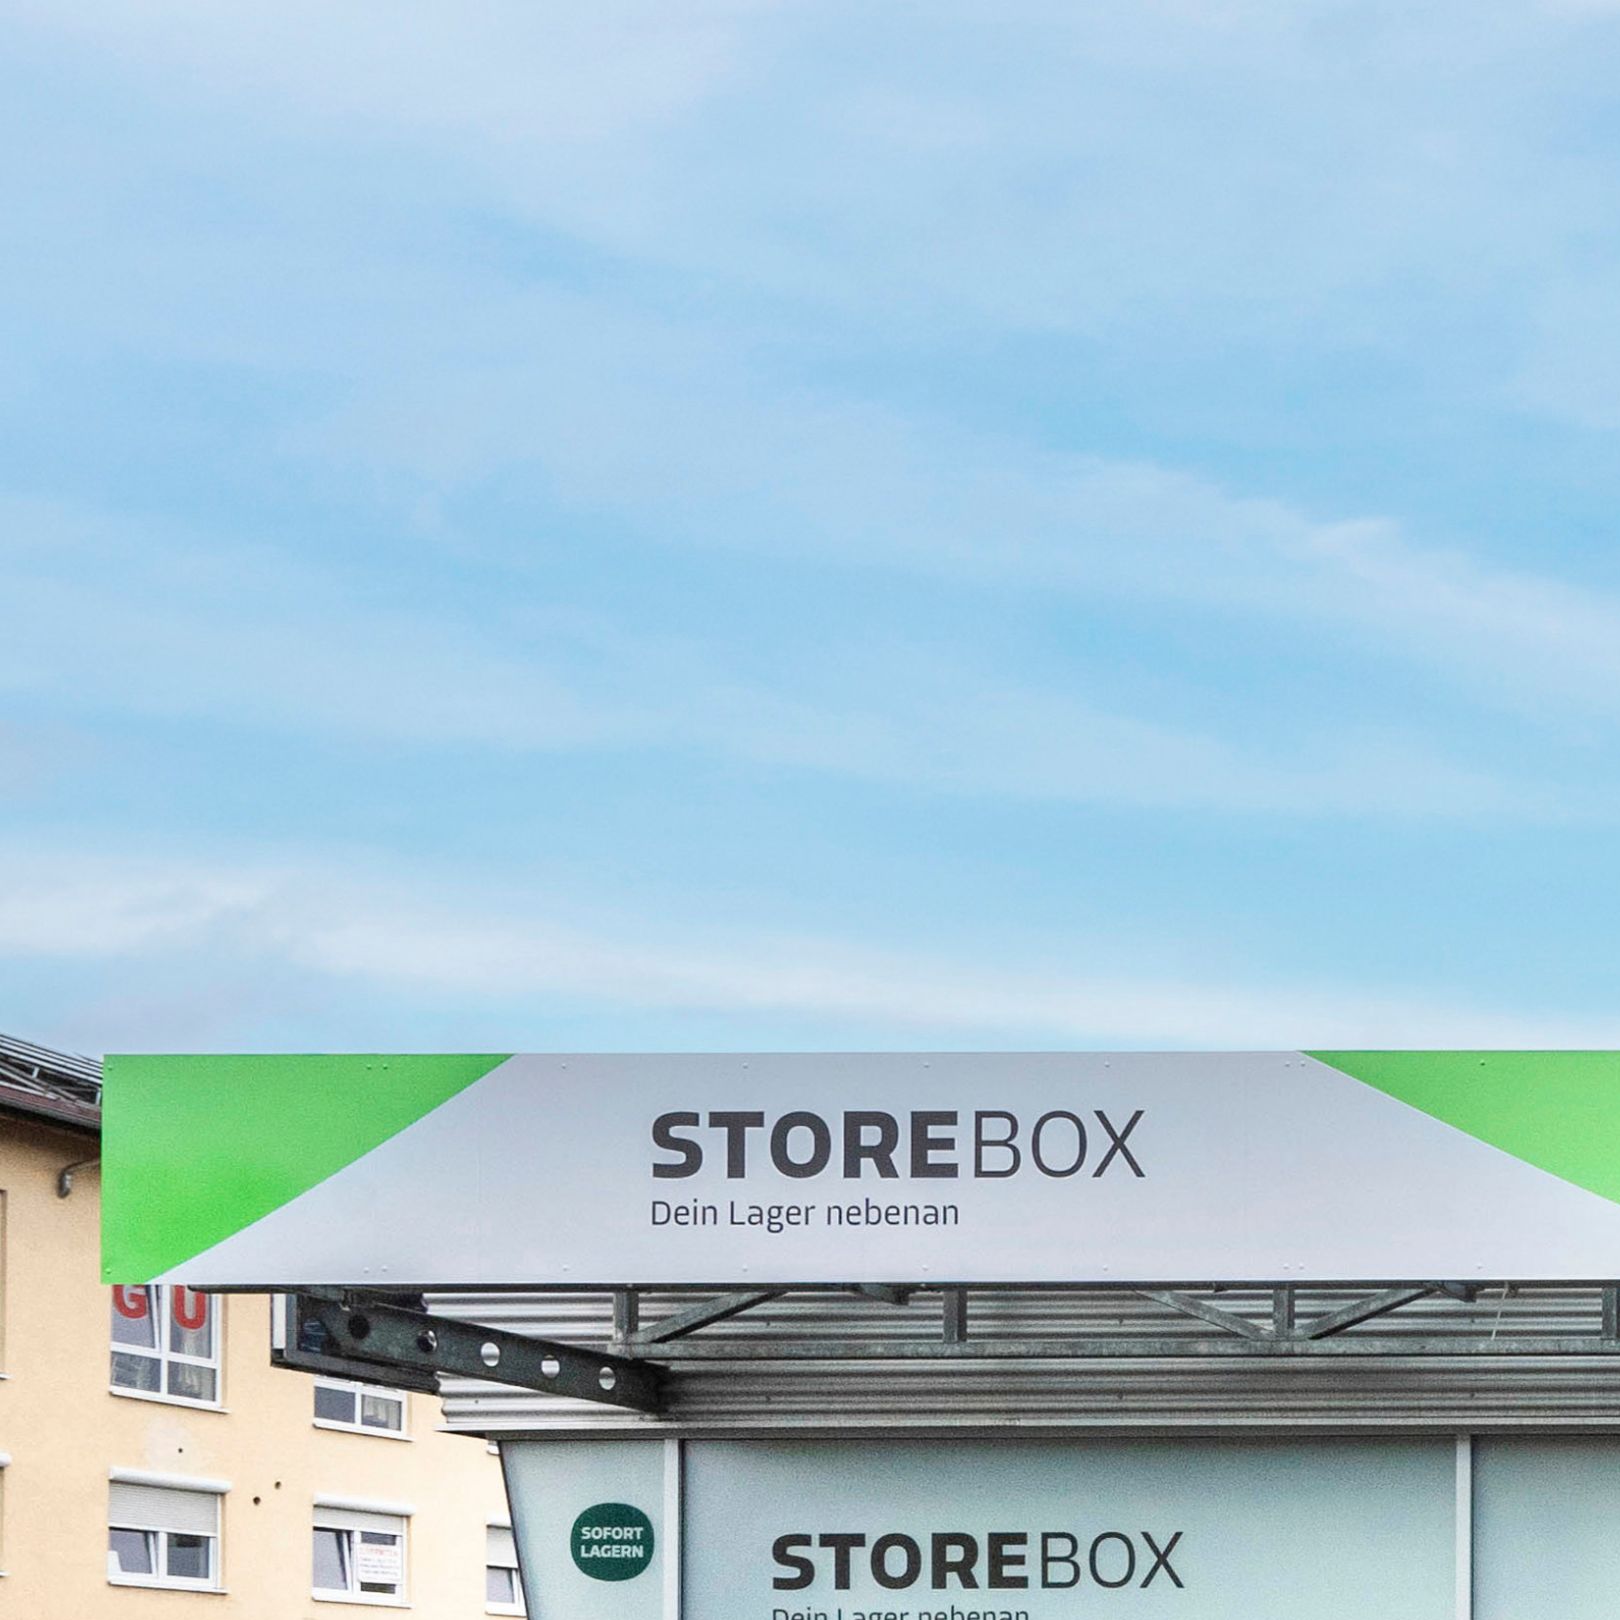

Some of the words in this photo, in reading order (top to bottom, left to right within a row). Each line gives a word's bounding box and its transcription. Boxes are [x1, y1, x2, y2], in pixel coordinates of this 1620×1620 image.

[650, 1109, 1146, 1179] STOREBOX
[650, 1199, 718, 1226] Dein
[729, 1200, 816, 1233] Lager
[827, 1198, 960, 1225] nebenan
[580, 1526, 644, 1540] SOFORT
[580, 1545, 644, 1558] LAGERN
[772, 1531, 1185, 1590] STOREBOX
